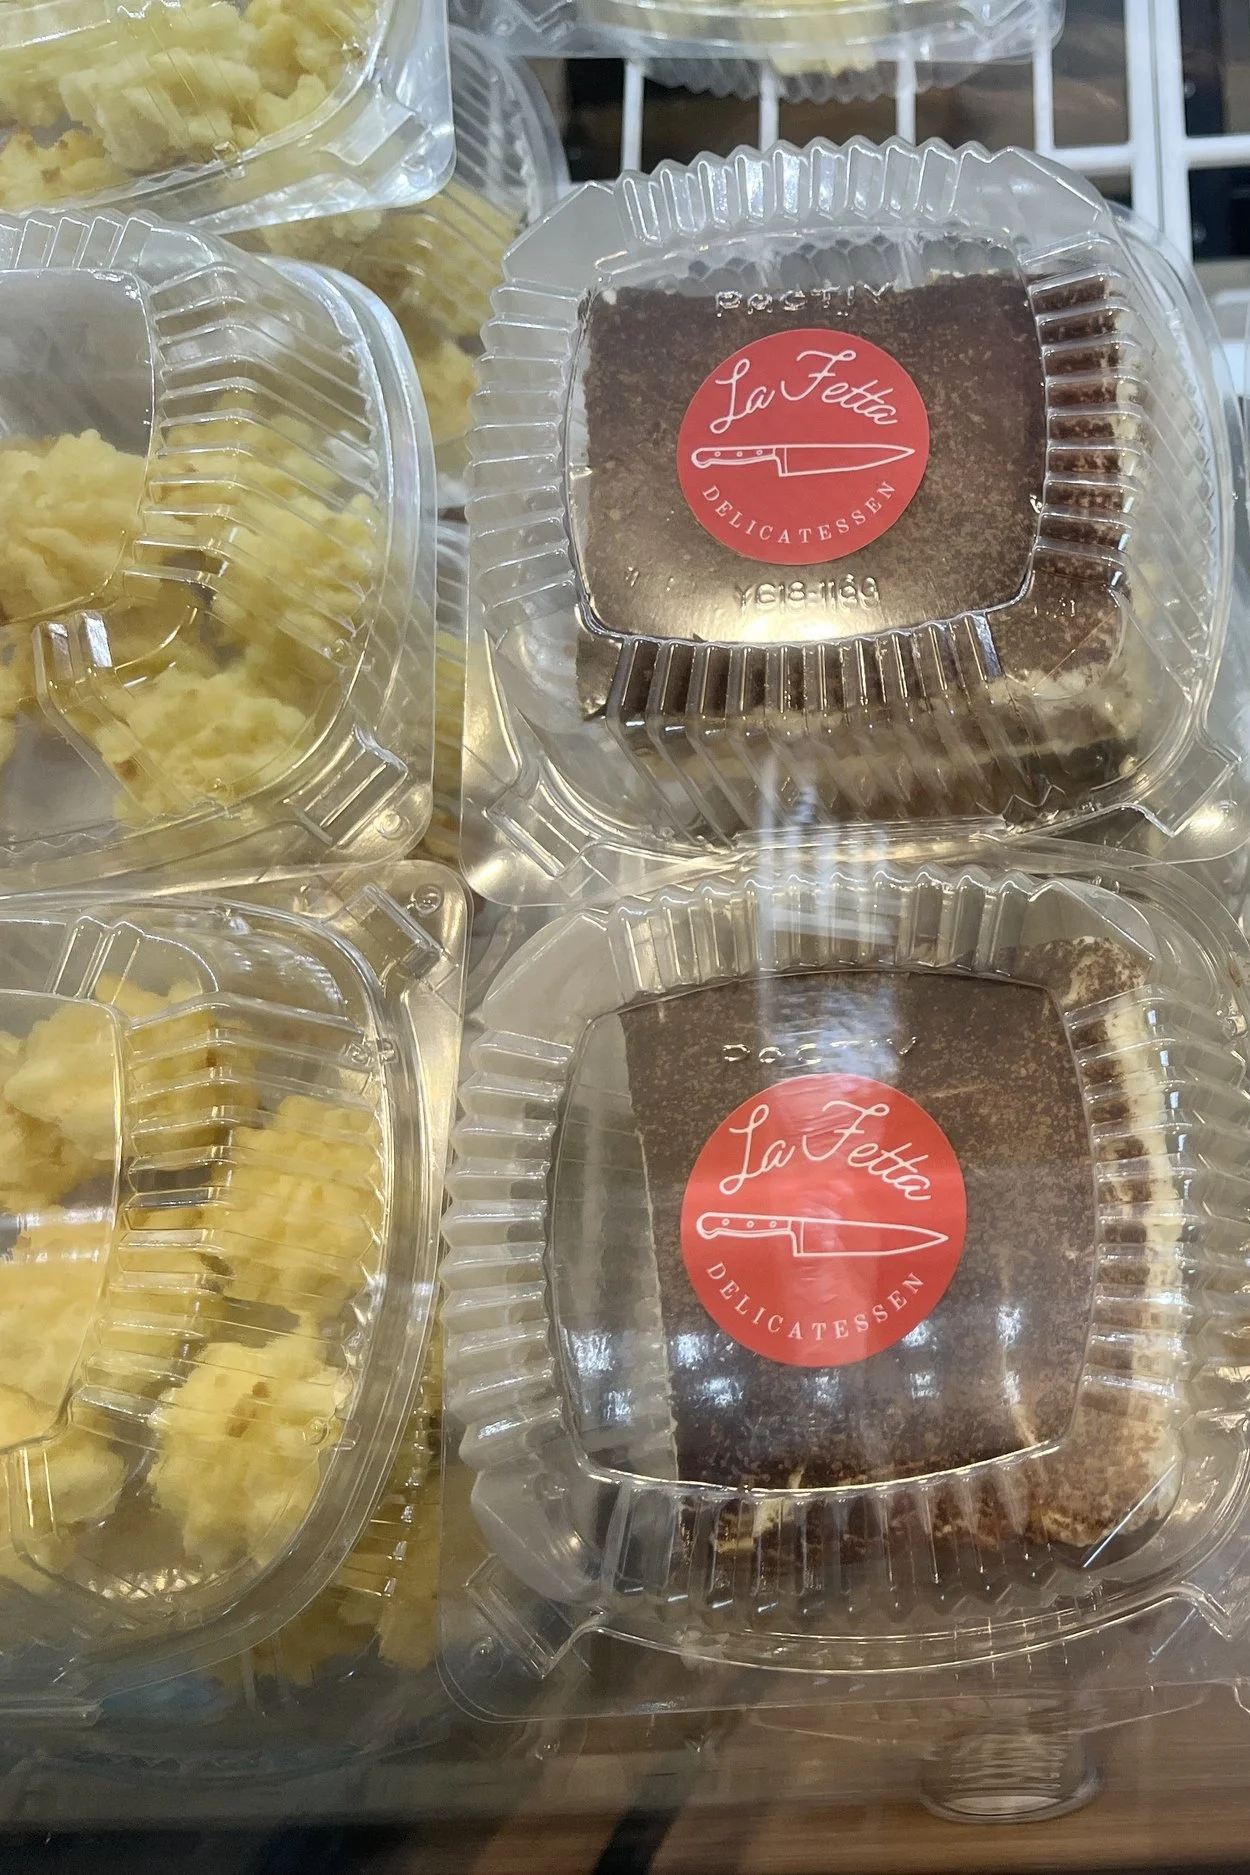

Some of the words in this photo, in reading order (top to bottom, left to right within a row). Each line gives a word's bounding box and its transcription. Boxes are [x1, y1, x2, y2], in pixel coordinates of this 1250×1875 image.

[710, 358, 776, 434] La
[780, 350, 898, 425] Fetta
[702, 481, 896, 545] DELICATESSEN
[718, 1103, 796, 1196] La
[801, 1100, 933, 1201] Fetta
[705, 1262, 925, 1341] DELICATESSEN
